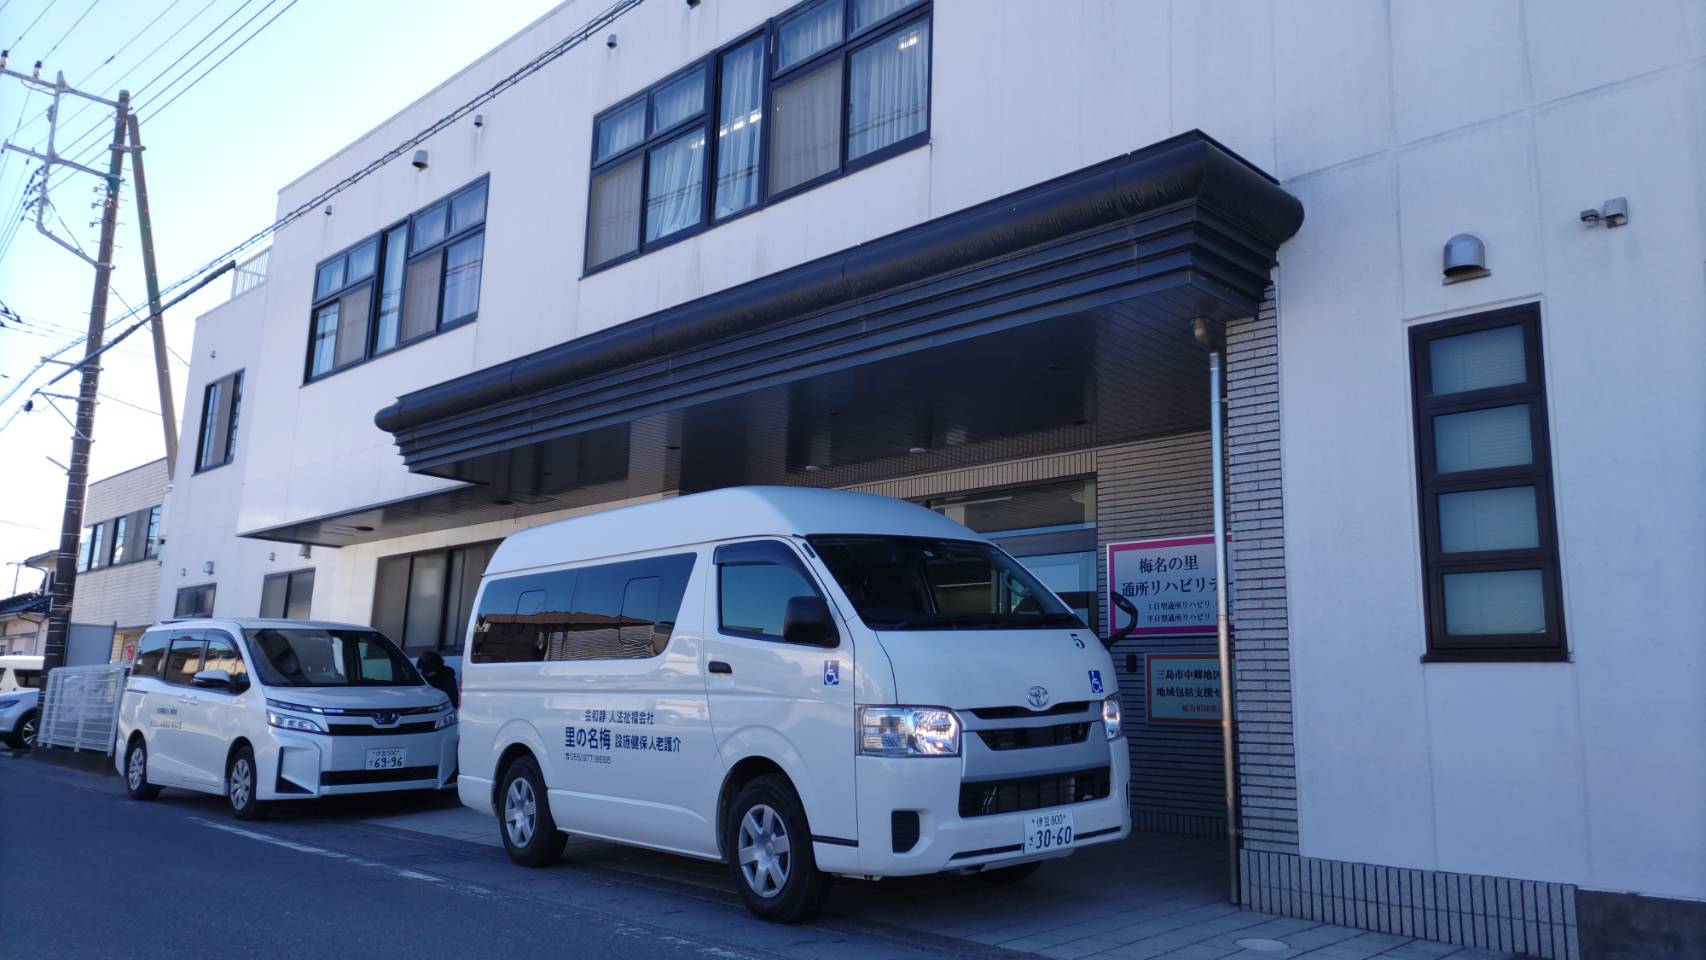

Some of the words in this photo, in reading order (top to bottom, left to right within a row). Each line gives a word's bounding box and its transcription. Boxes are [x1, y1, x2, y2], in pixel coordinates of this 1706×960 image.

[1139, 554, 1199, 574] 梅名の里
[1070, 633, 1085, 649] 5
[1036, 825, 1072, 849] 30-60
